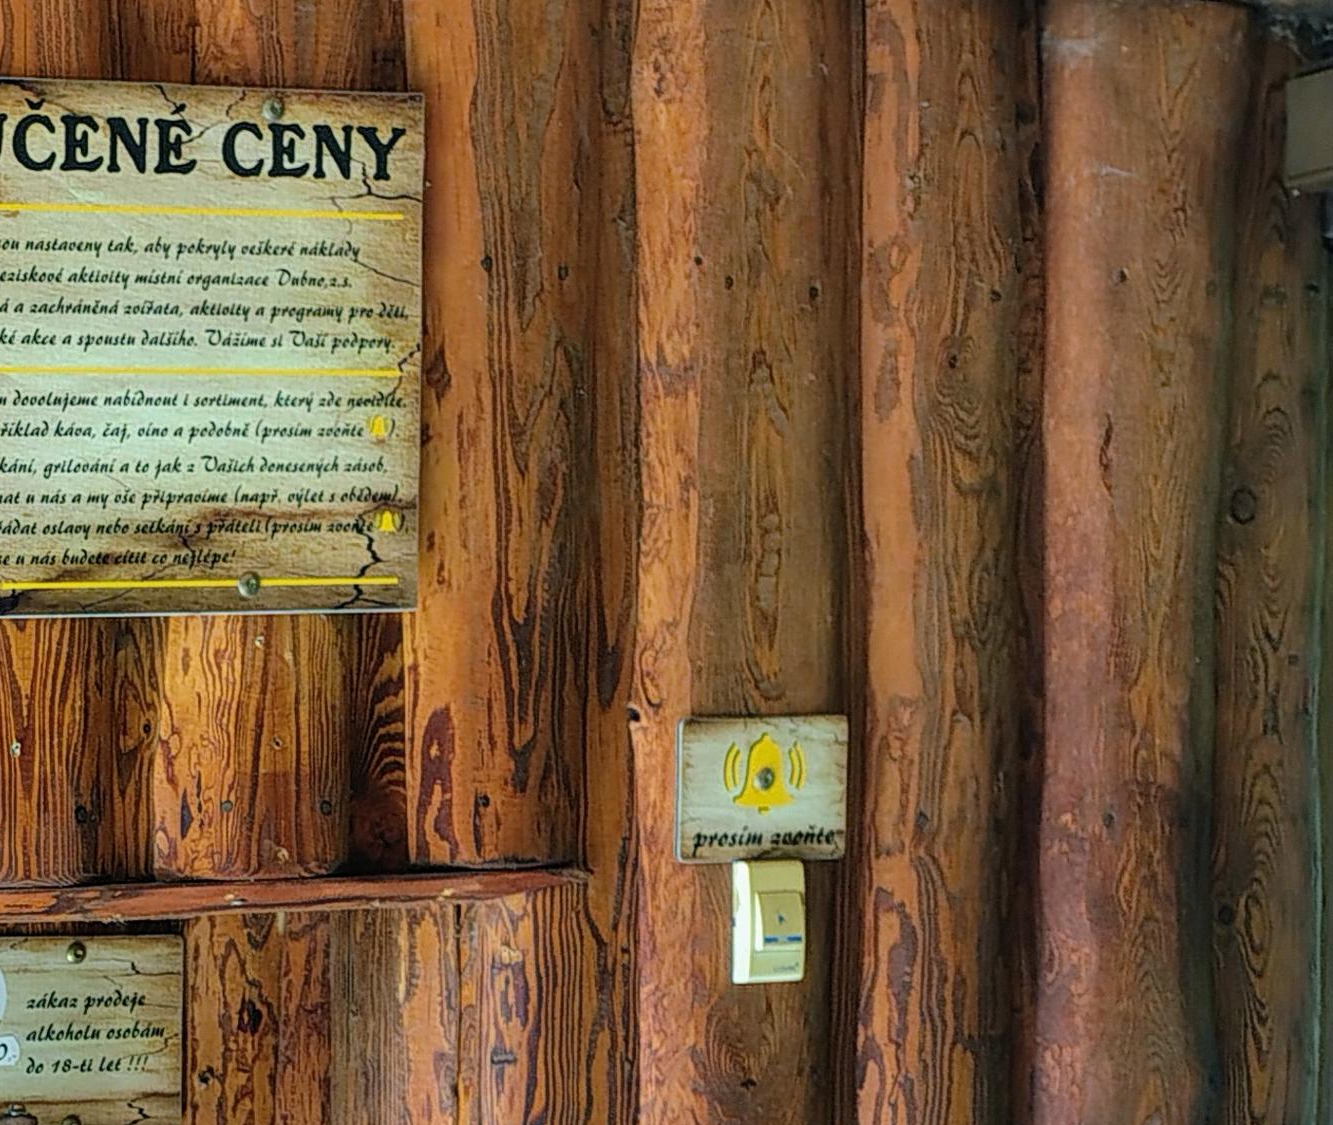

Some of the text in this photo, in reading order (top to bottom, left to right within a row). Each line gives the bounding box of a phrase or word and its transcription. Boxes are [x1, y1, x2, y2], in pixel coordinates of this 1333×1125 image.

[222, 123, 407, 182] CENY
[25, 239, 102, 258] nastaveny
[108, 237, 138, 255] tak,
[144, 237, 171, 259] aby
[176, 238, 235, 260] pokryly
[241, 239, 295, 257] veškeré
[300, 240, 360, 260] náklady
[68, 265, 129, 290] aktivity
[134, 269, 184, 285] místní
[186, 270, 269, 291] organizace
[29, 297, 119, 315] zachráněná
[123, 300, 183, 317] zvířata,
[190, 299, 251, 321] aktivity
[270, 303, 343, 323] programy
[347, 305, 375, 320] pro
[21, 328, 56, 346] akce
[76, 332, 136, 352] spoustu
[141, 329, 198, 348] dalšího.
[205, 329, 266, 348] Vážíme
[289, 330, 328, 348] Vaší
[331, 332, 396, 354] podpory.
[12, 389, 98, 412] dovolujeme
[104, 390, 177, 407] nabídnout
[193, 393, 268, 408] sortiment,
[274, 392, 313, 412] který
[319, 391, 341, 408] zde
[54, 421, 97, 438] káva,
[103, 422, 131, 443] čaj,
[138, 424, 168, 438] víno
[188, 421, 251, 443] podobně
[255, 419, 312, 443] (prosím
[318, 422, 364, 438] zvoňte
[42, 457, 115, 478] grilování
[155, 456, 181, 478] jak
[200, 454, 254, 473] Vašich
[259, 456, 339, 477] donesených
[40, 489, 66, 505] nás
[114, 490, 136, 504] vše
[142, 490, 228, 510] připravíme
[287, 488, 324, 510] výlet
[42, 520, 90, 540] oslavy
[96, 517, 129, 534] nebo
[265, 516, 322, 539] (prosím
[30, 550, 56, 566] nás
[61, 548, 110, 566] budete
[173, 548, 237, 569] nejlépe!
[692, 824, 835, 857] prosím zvoňte
[26, 989, 146, 1015] zákaz prodeje
[26, 1020, 165, 1042] alkoholu osobám
[26, 1057, 44, 1074] do
[51, 1058, 93, 1073] 18-ti
[98, 1056, 121, 1072] let
